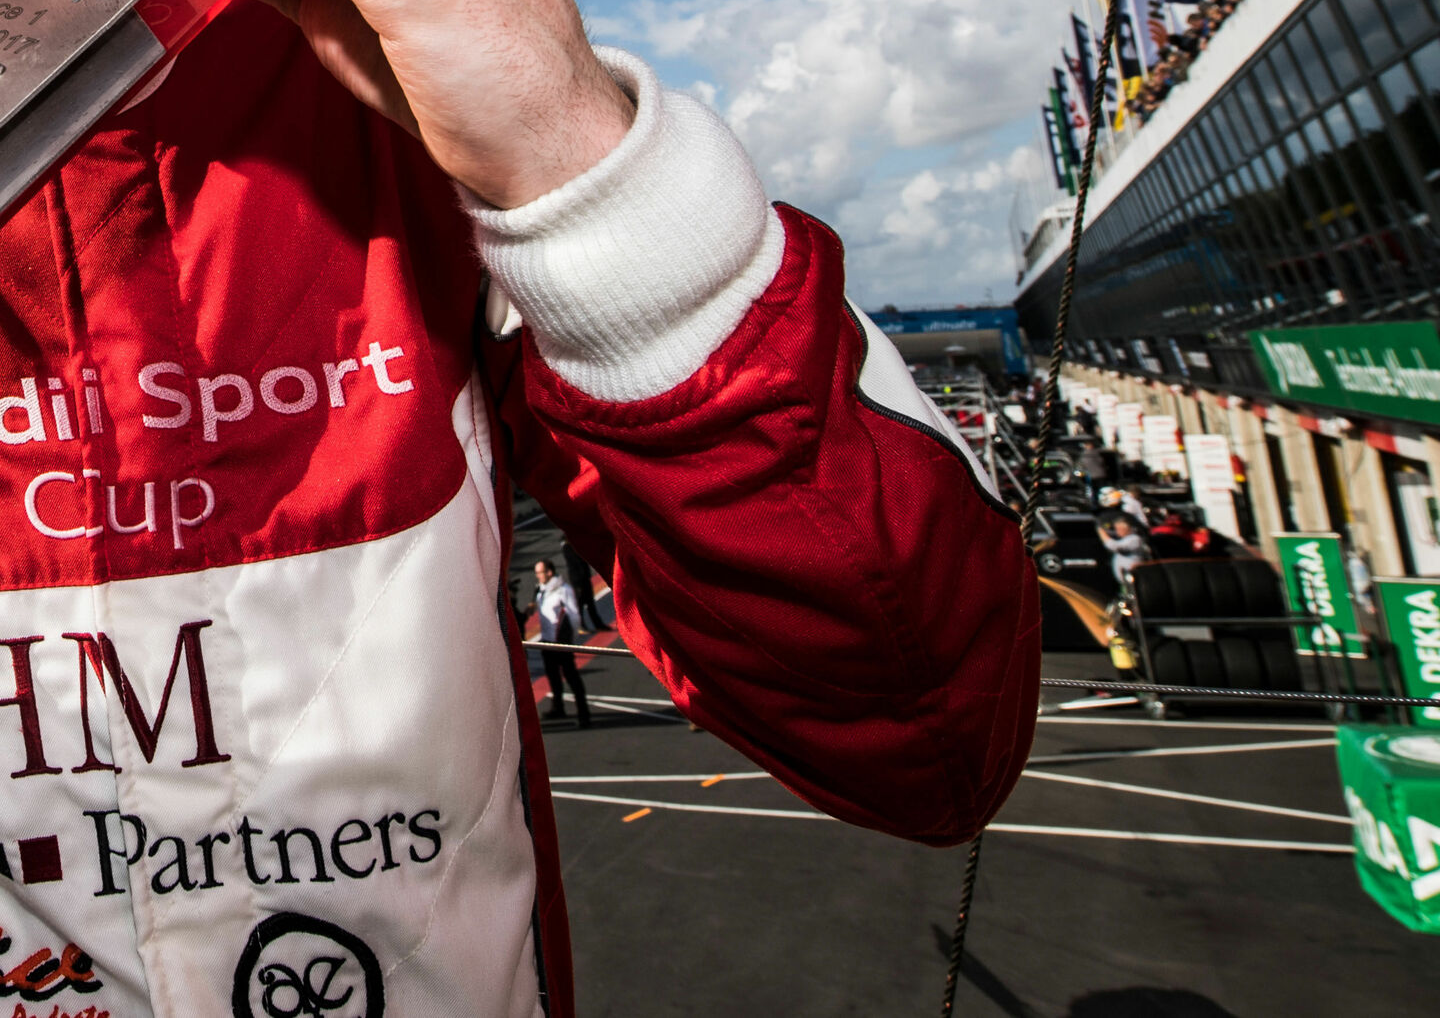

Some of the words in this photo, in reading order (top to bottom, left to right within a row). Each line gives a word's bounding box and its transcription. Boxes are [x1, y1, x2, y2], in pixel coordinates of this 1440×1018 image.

[29, 8, 49, 26] 1
[138, 341, 415, 442] Sport
[24, 468, 215, 549] Cup
[1295, 540, 1336, 617] DEKRA
[1404, 589, 1440, 684] DEKRA
[82, 808, 443, 898] Partners
